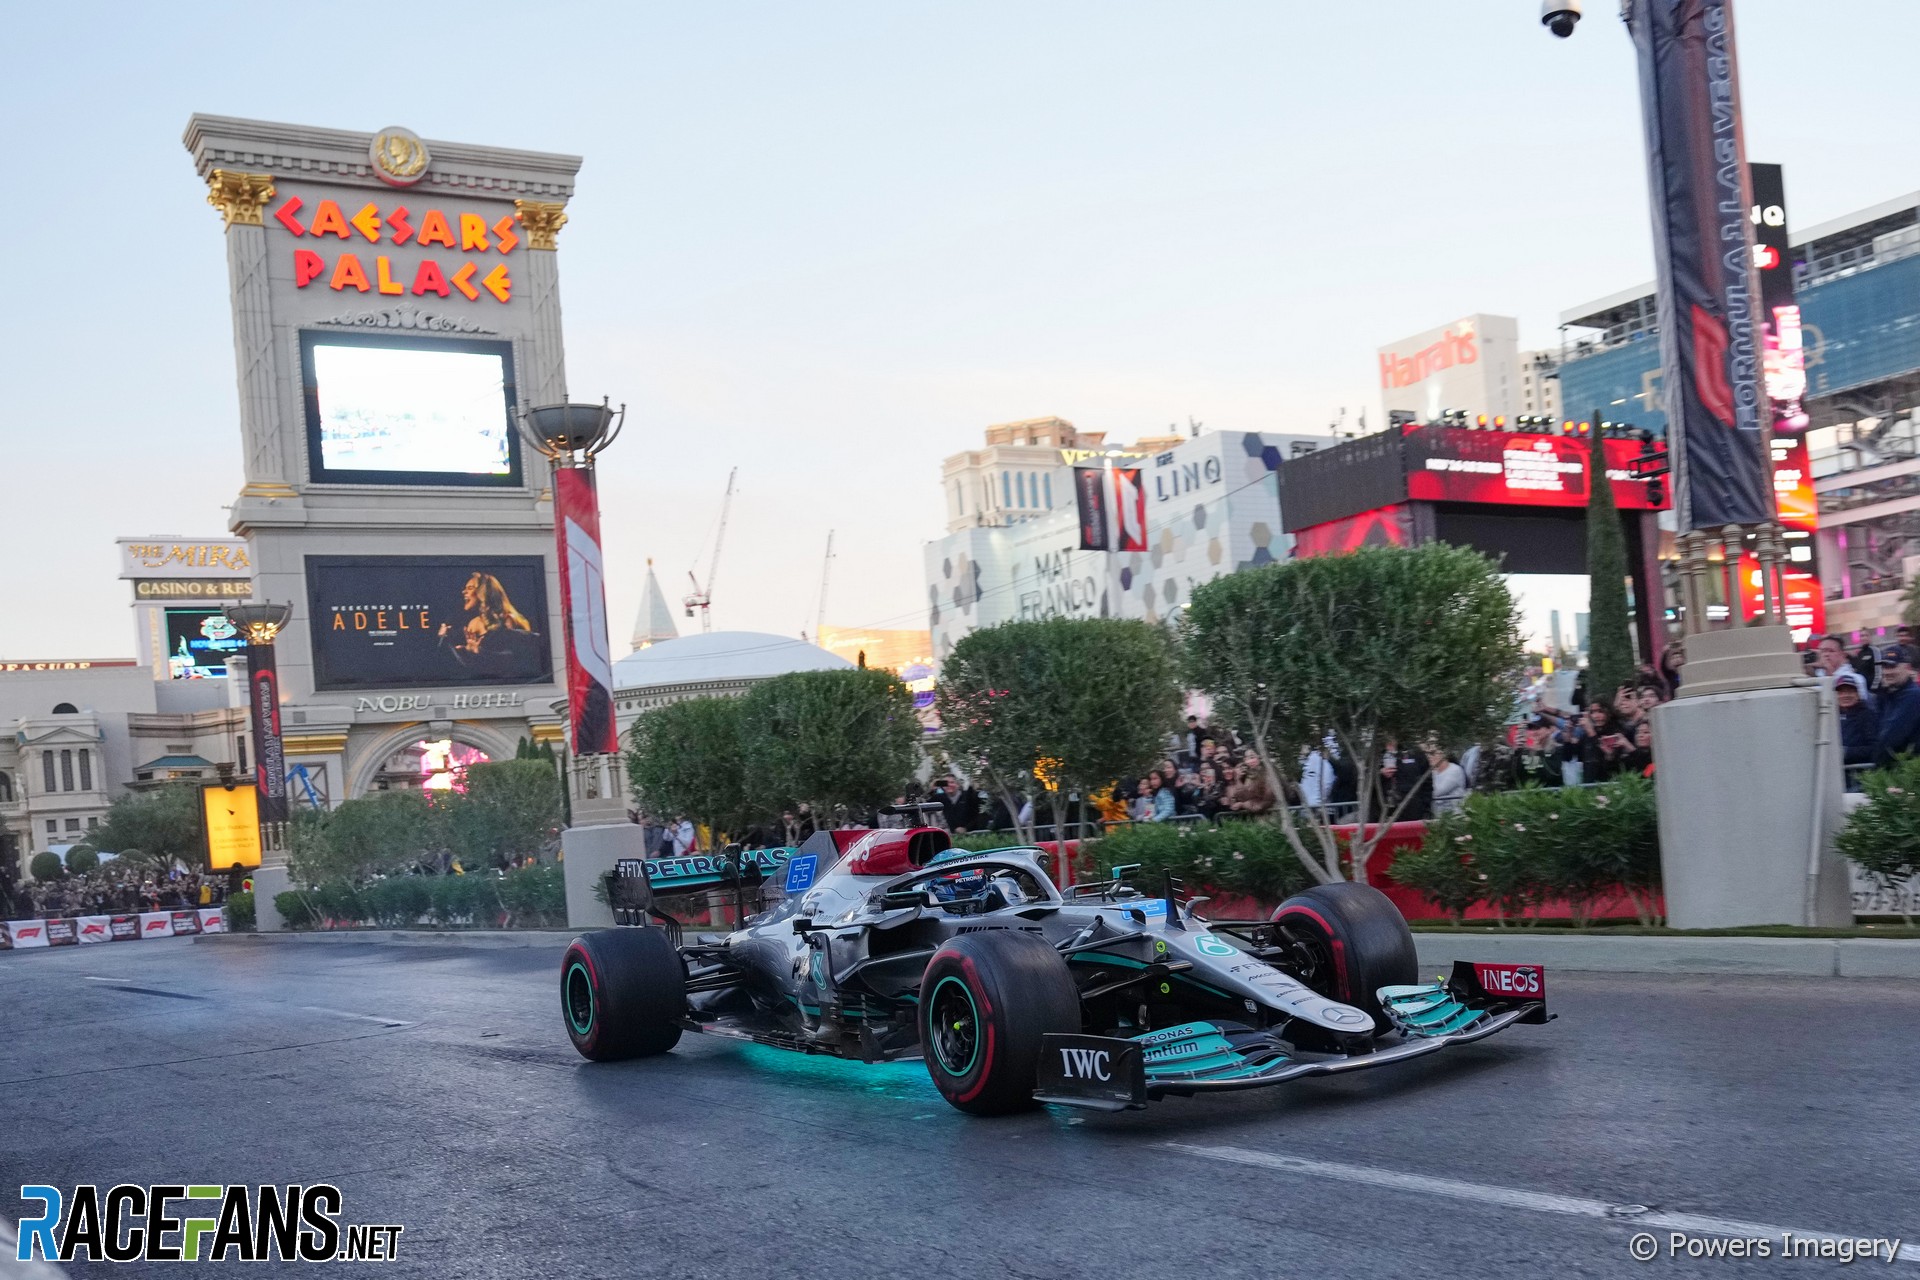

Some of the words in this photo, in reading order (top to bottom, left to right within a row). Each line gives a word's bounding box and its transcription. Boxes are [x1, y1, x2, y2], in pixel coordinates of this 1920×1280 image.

[274, 195, 520, 254] CAESARS
[294, 249, 512, 303] PALACE
[1156, 455, 1222, 502] LINQ
[128, 544, 164, 558] THE
[137, 582, 202, 595] CASINO
[205, 584, 219, 595] &
[1020, 576, 1096, 621] FRANCO
[333, 611, 430, 631] ADELE
[357, 695, 432, 713] NOBU
[453, 692, 524, 709] HOTEL
[626, 861, 643, 878] FTX
[1483, 969, 1539, 993] INEOS
[1060, 1048, 1111, 1081] IWC
